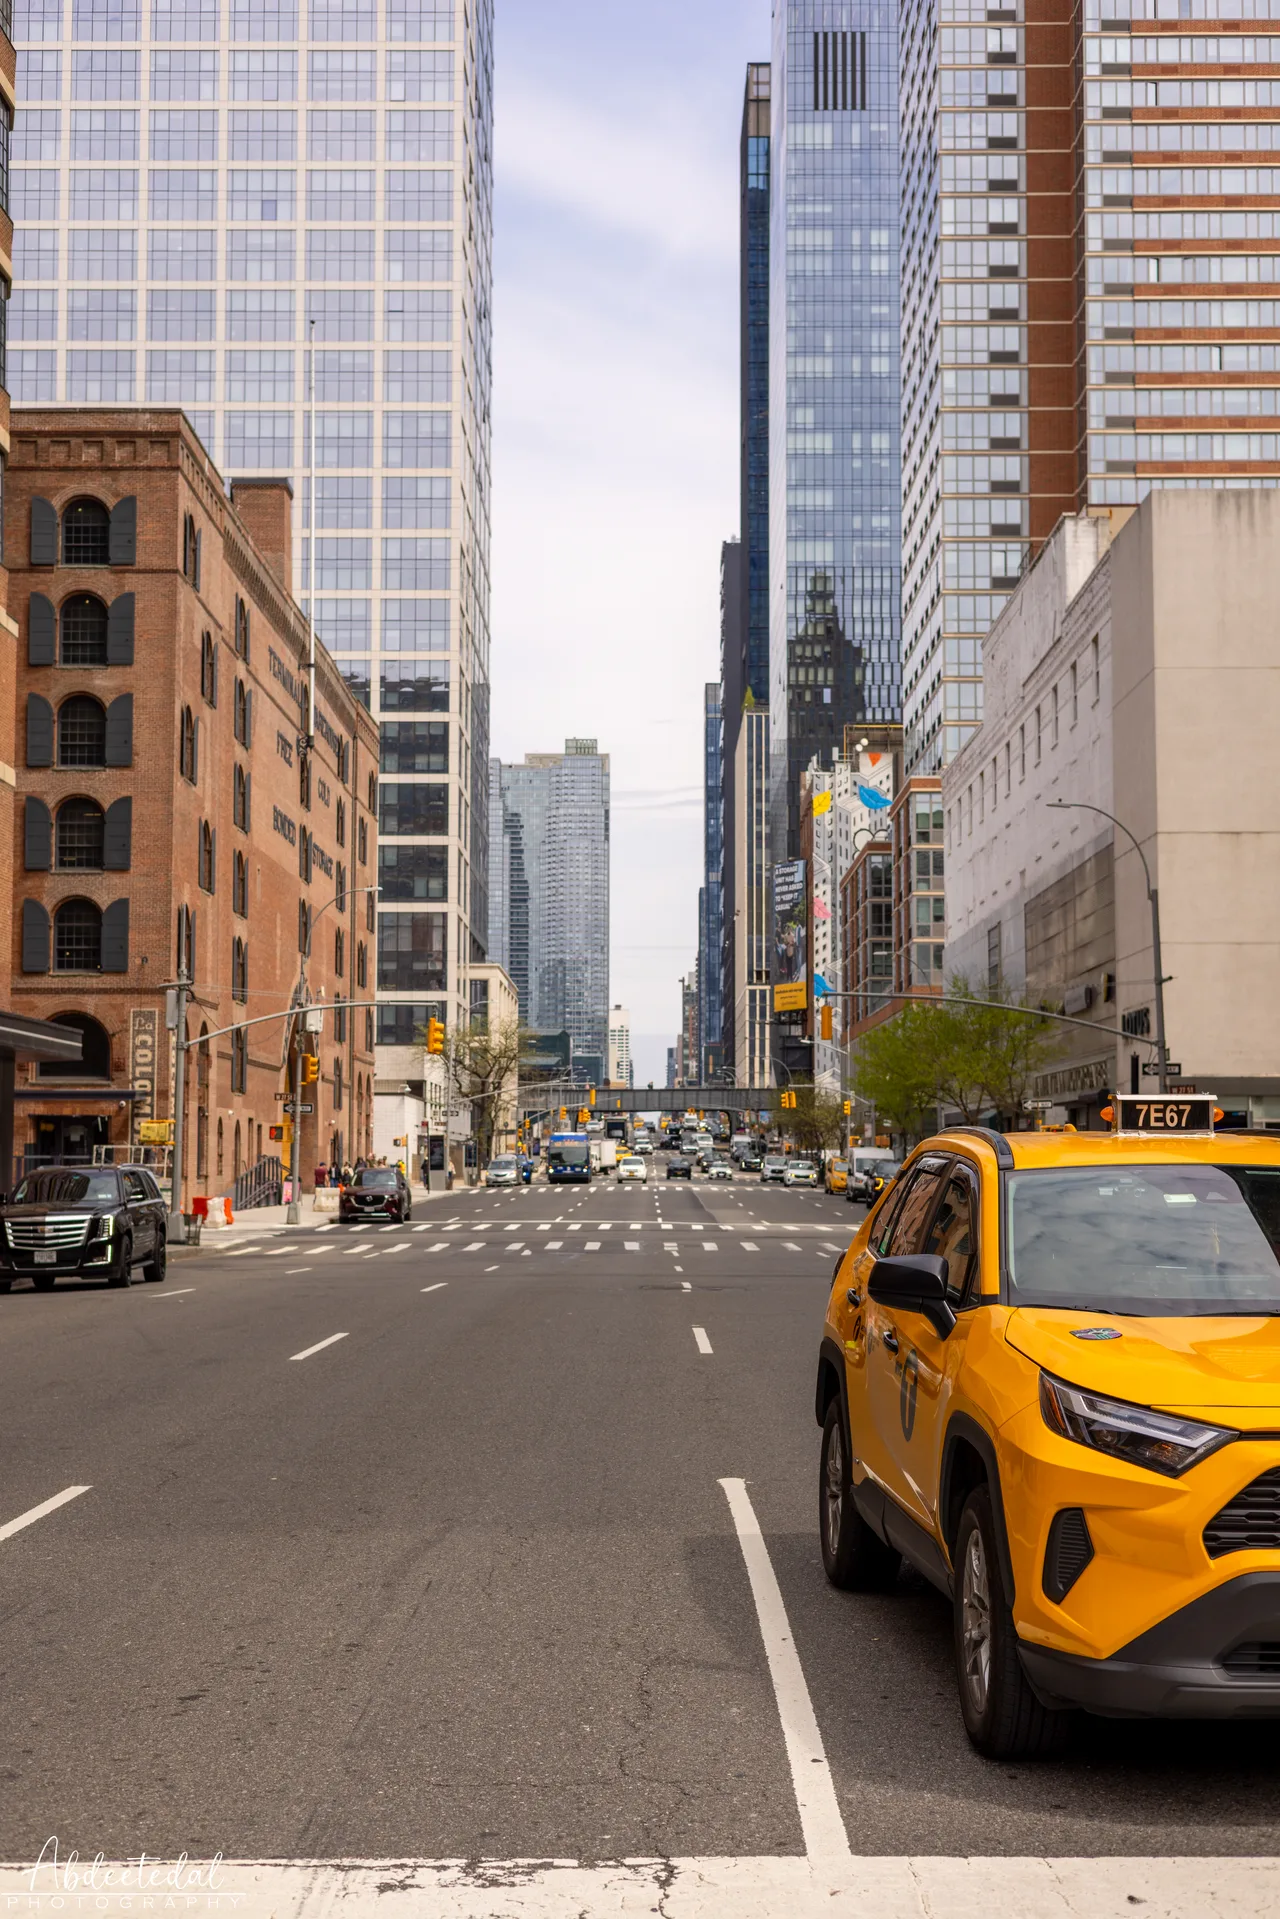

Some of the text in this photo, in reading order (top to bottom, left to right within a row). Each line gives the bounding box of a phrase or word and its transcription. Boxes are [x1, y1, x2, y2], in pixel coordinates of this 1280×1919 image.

[268, 645, 303, 711] TERMINAL
[276, 729, 331, 808] FREE COLD
[273, 804, 334, 880] BONDED STORAGE
[775, 882, 803, 893] NEVER ASKED
[1122, 1007, 1150, 1036] LOTUS
[1135, 1104, 1192, 1127] 7E67
